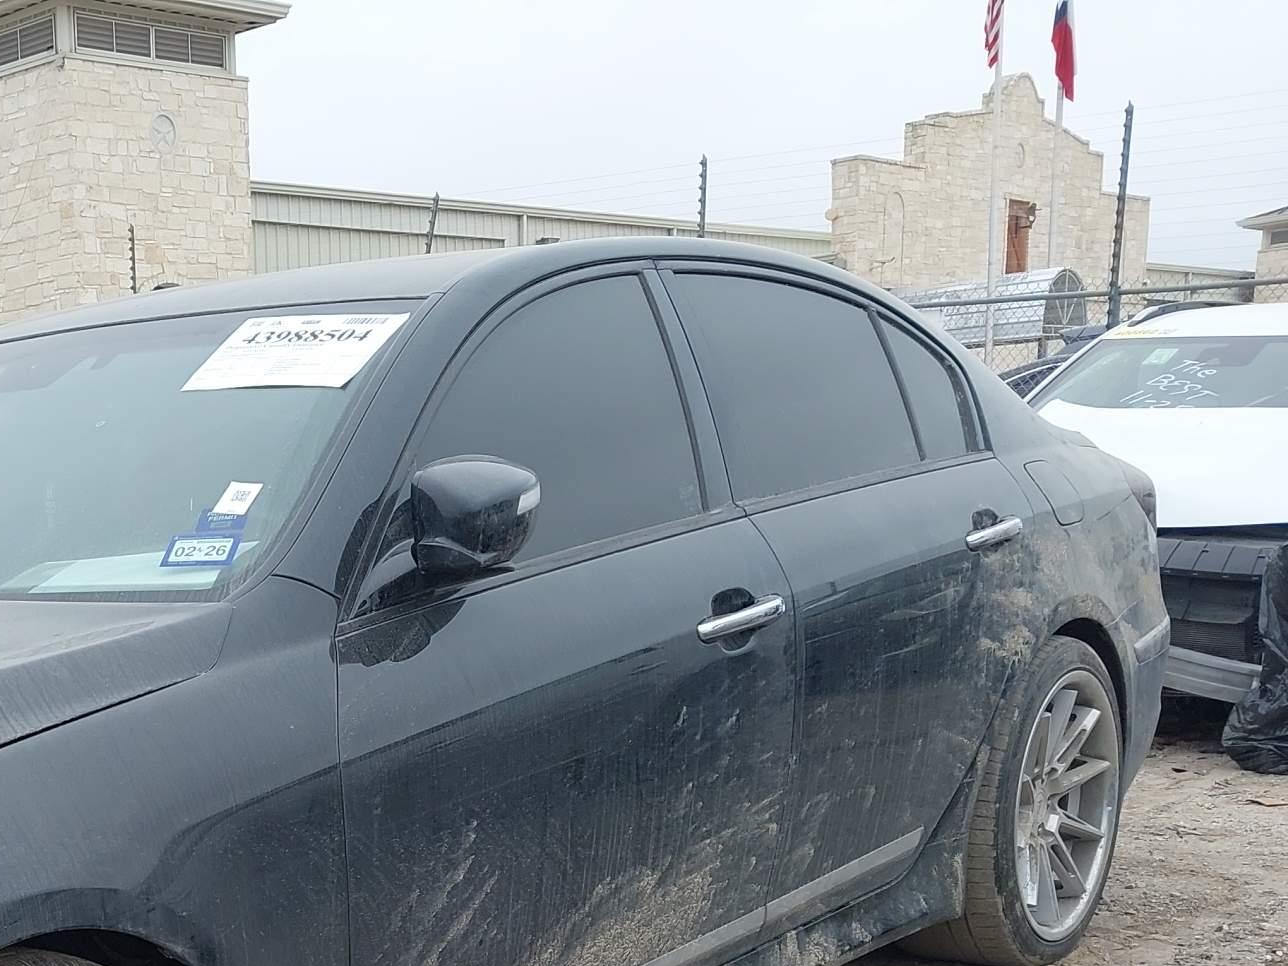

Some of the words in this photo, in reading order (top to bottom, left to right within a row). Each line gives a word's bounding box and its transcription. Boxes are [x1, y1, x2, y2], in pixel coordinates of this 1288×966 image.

[241, 329, 374, 345] 43988504
[1169, 359, 1217, 378] The
[1146, 373, 1220, 401] BEST
[1119, 390, 1195, 408] 11-2
[174, 546, 197, 558] 02
[204, 545, 228, 557] 26
